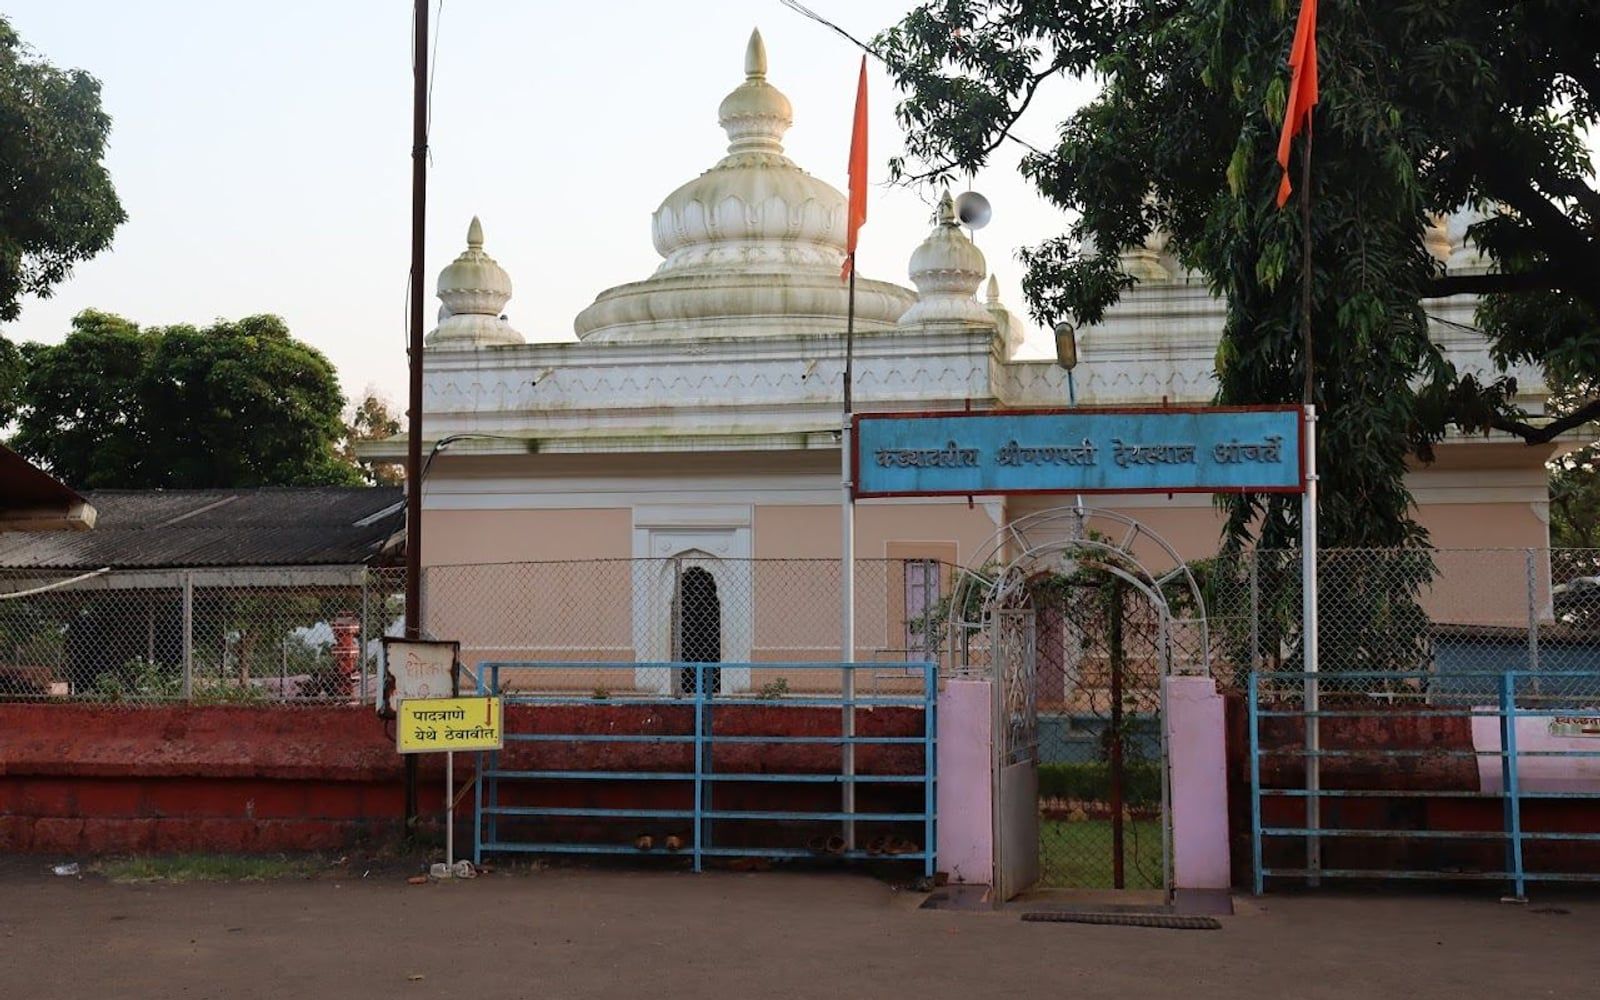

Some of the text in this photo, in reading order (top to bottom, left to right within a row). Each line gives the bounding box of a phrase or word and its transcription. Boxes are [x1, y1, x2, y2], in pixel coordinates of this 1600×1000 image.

[996, 437, 1097, 467] श्रीगणपती
[1112, 438, 1196, 468] देवस्थान
[413, 706, 465, 722] पादत्राणे
[414, 726, 437, 741] येथे
